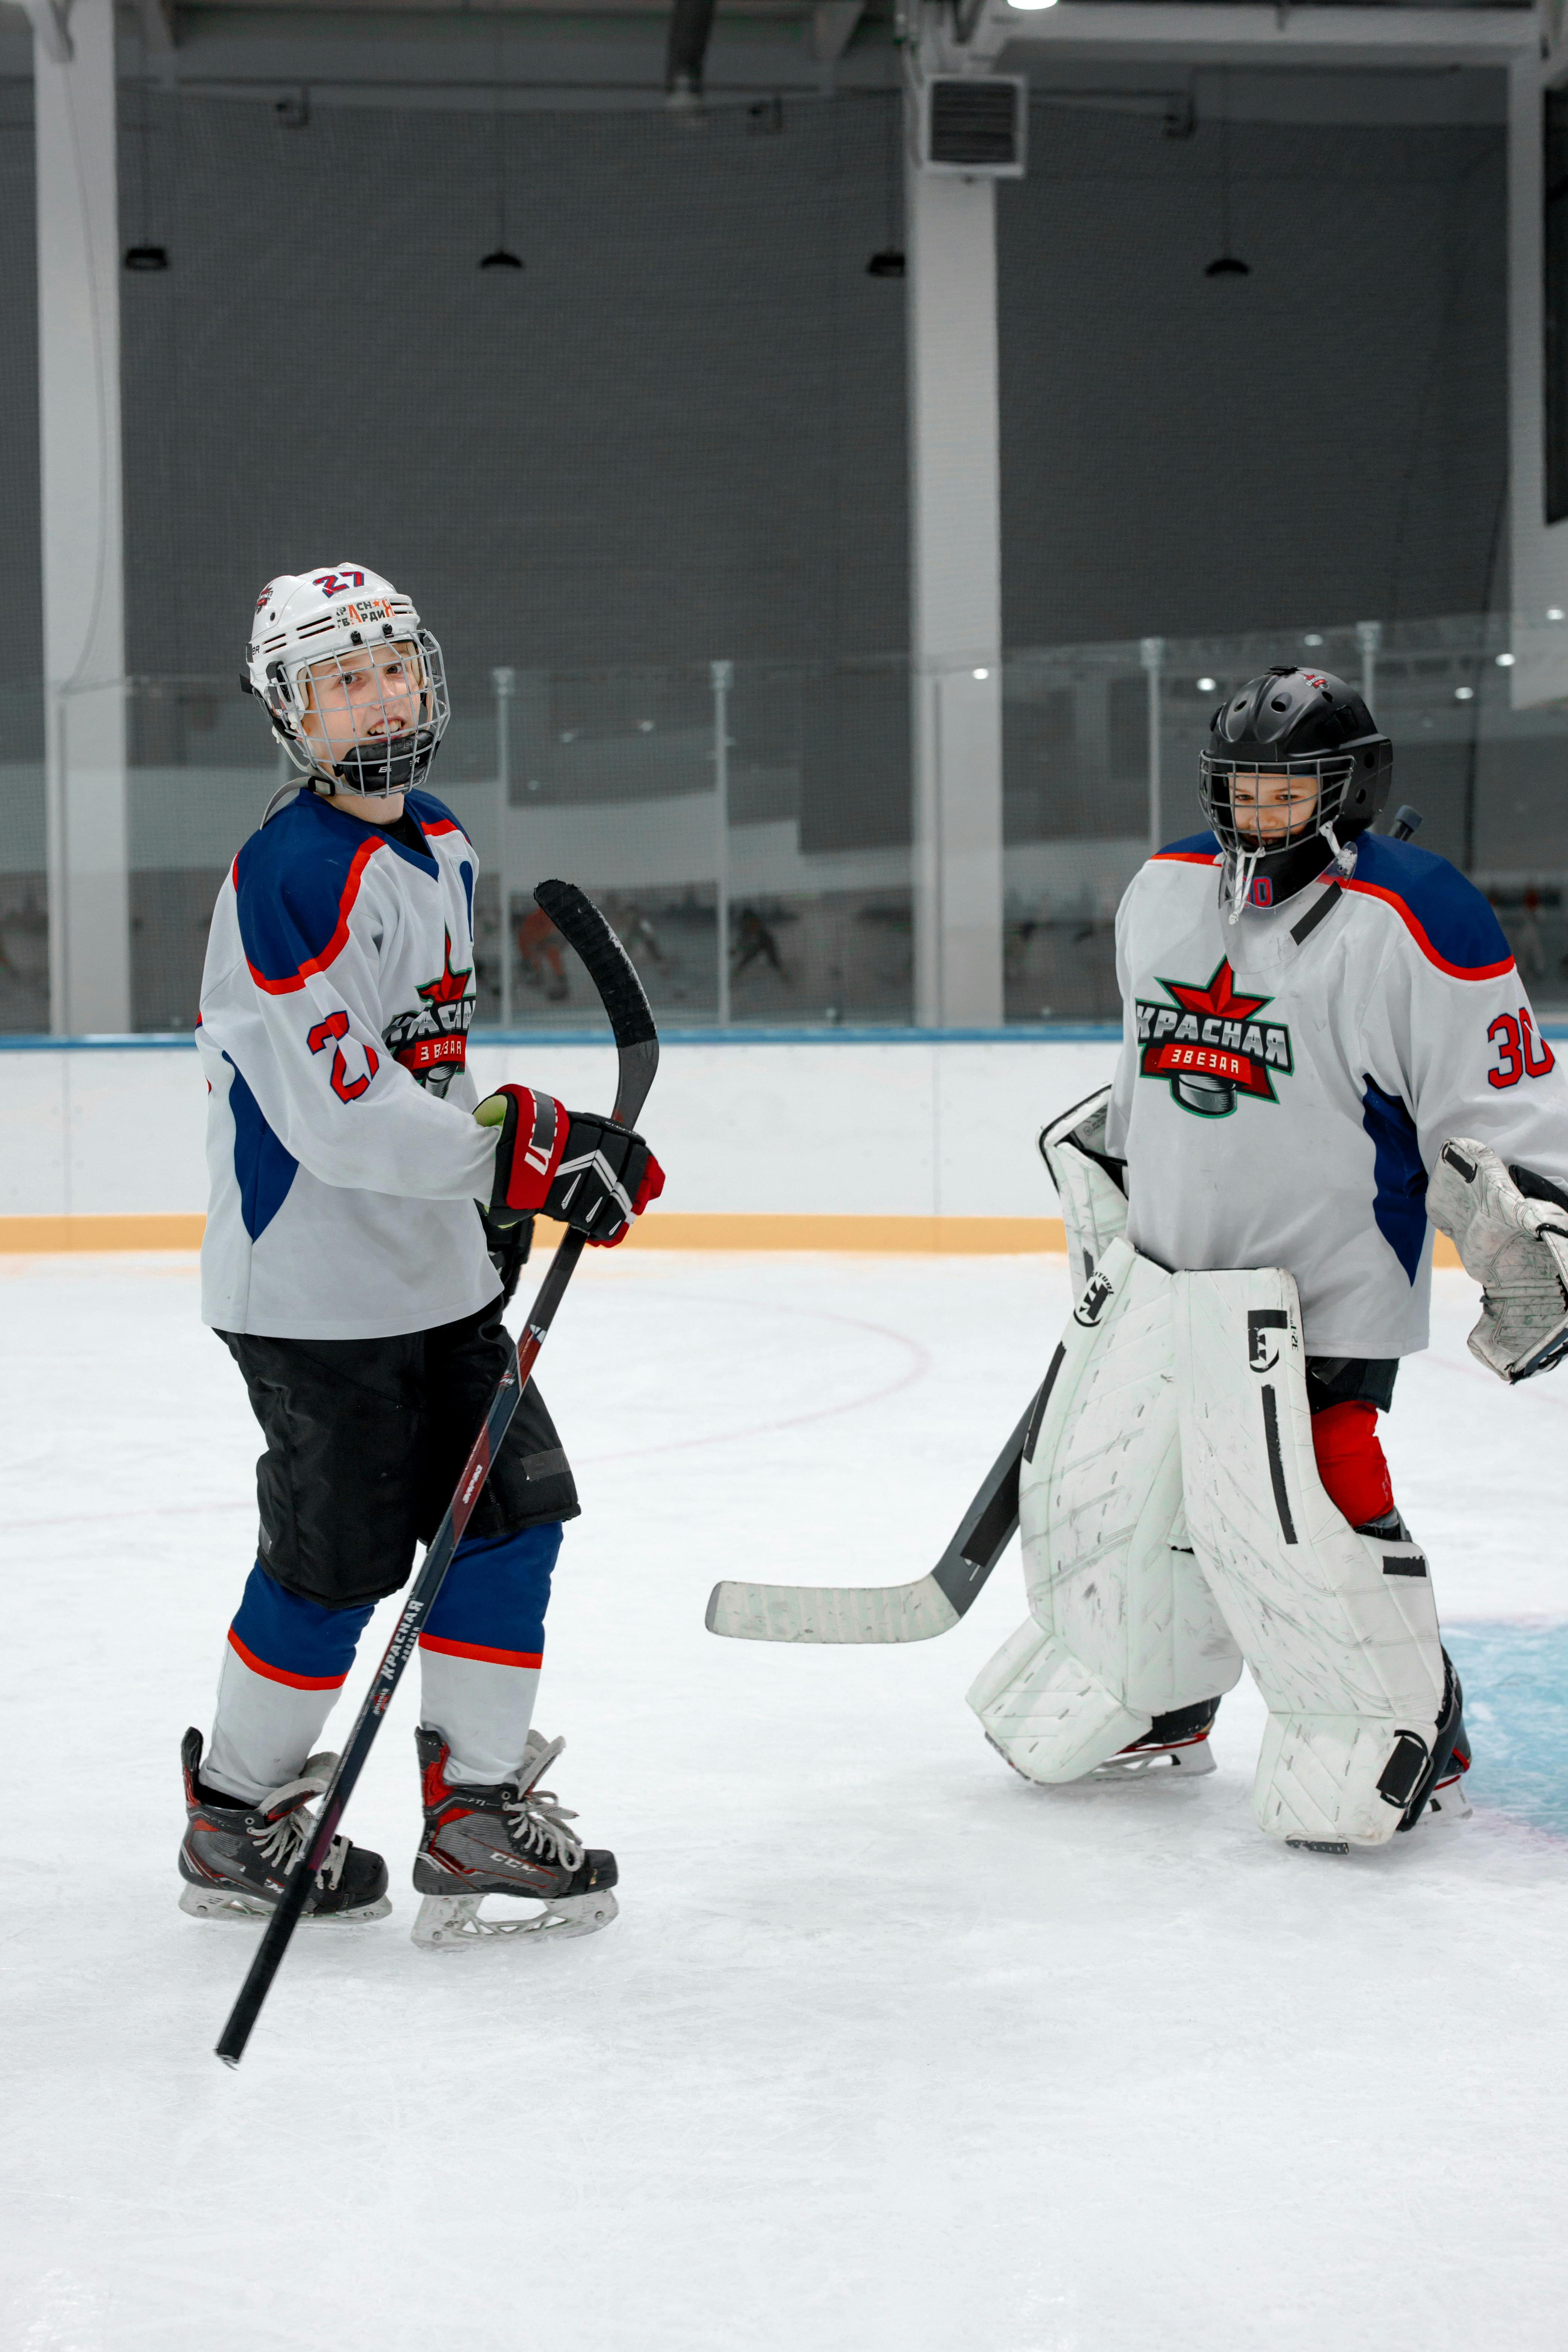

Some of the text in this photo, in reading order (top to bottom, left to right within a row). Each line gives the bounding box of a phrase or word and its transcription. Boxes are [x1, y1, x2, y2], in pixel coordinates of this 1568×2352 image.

[312, 571, 364, 598] 27
[421, 1040, 462, 1061] ЗВЗДА
[1137, 1005, 1288, 1067] КРАСНАЯ
[1487, 1006, 1555, 1090] 30
[1171, 1049, 1239, 1074] ЗВЕЗДА
[380, 1600, 425, 1680] КРАСНАЯ
